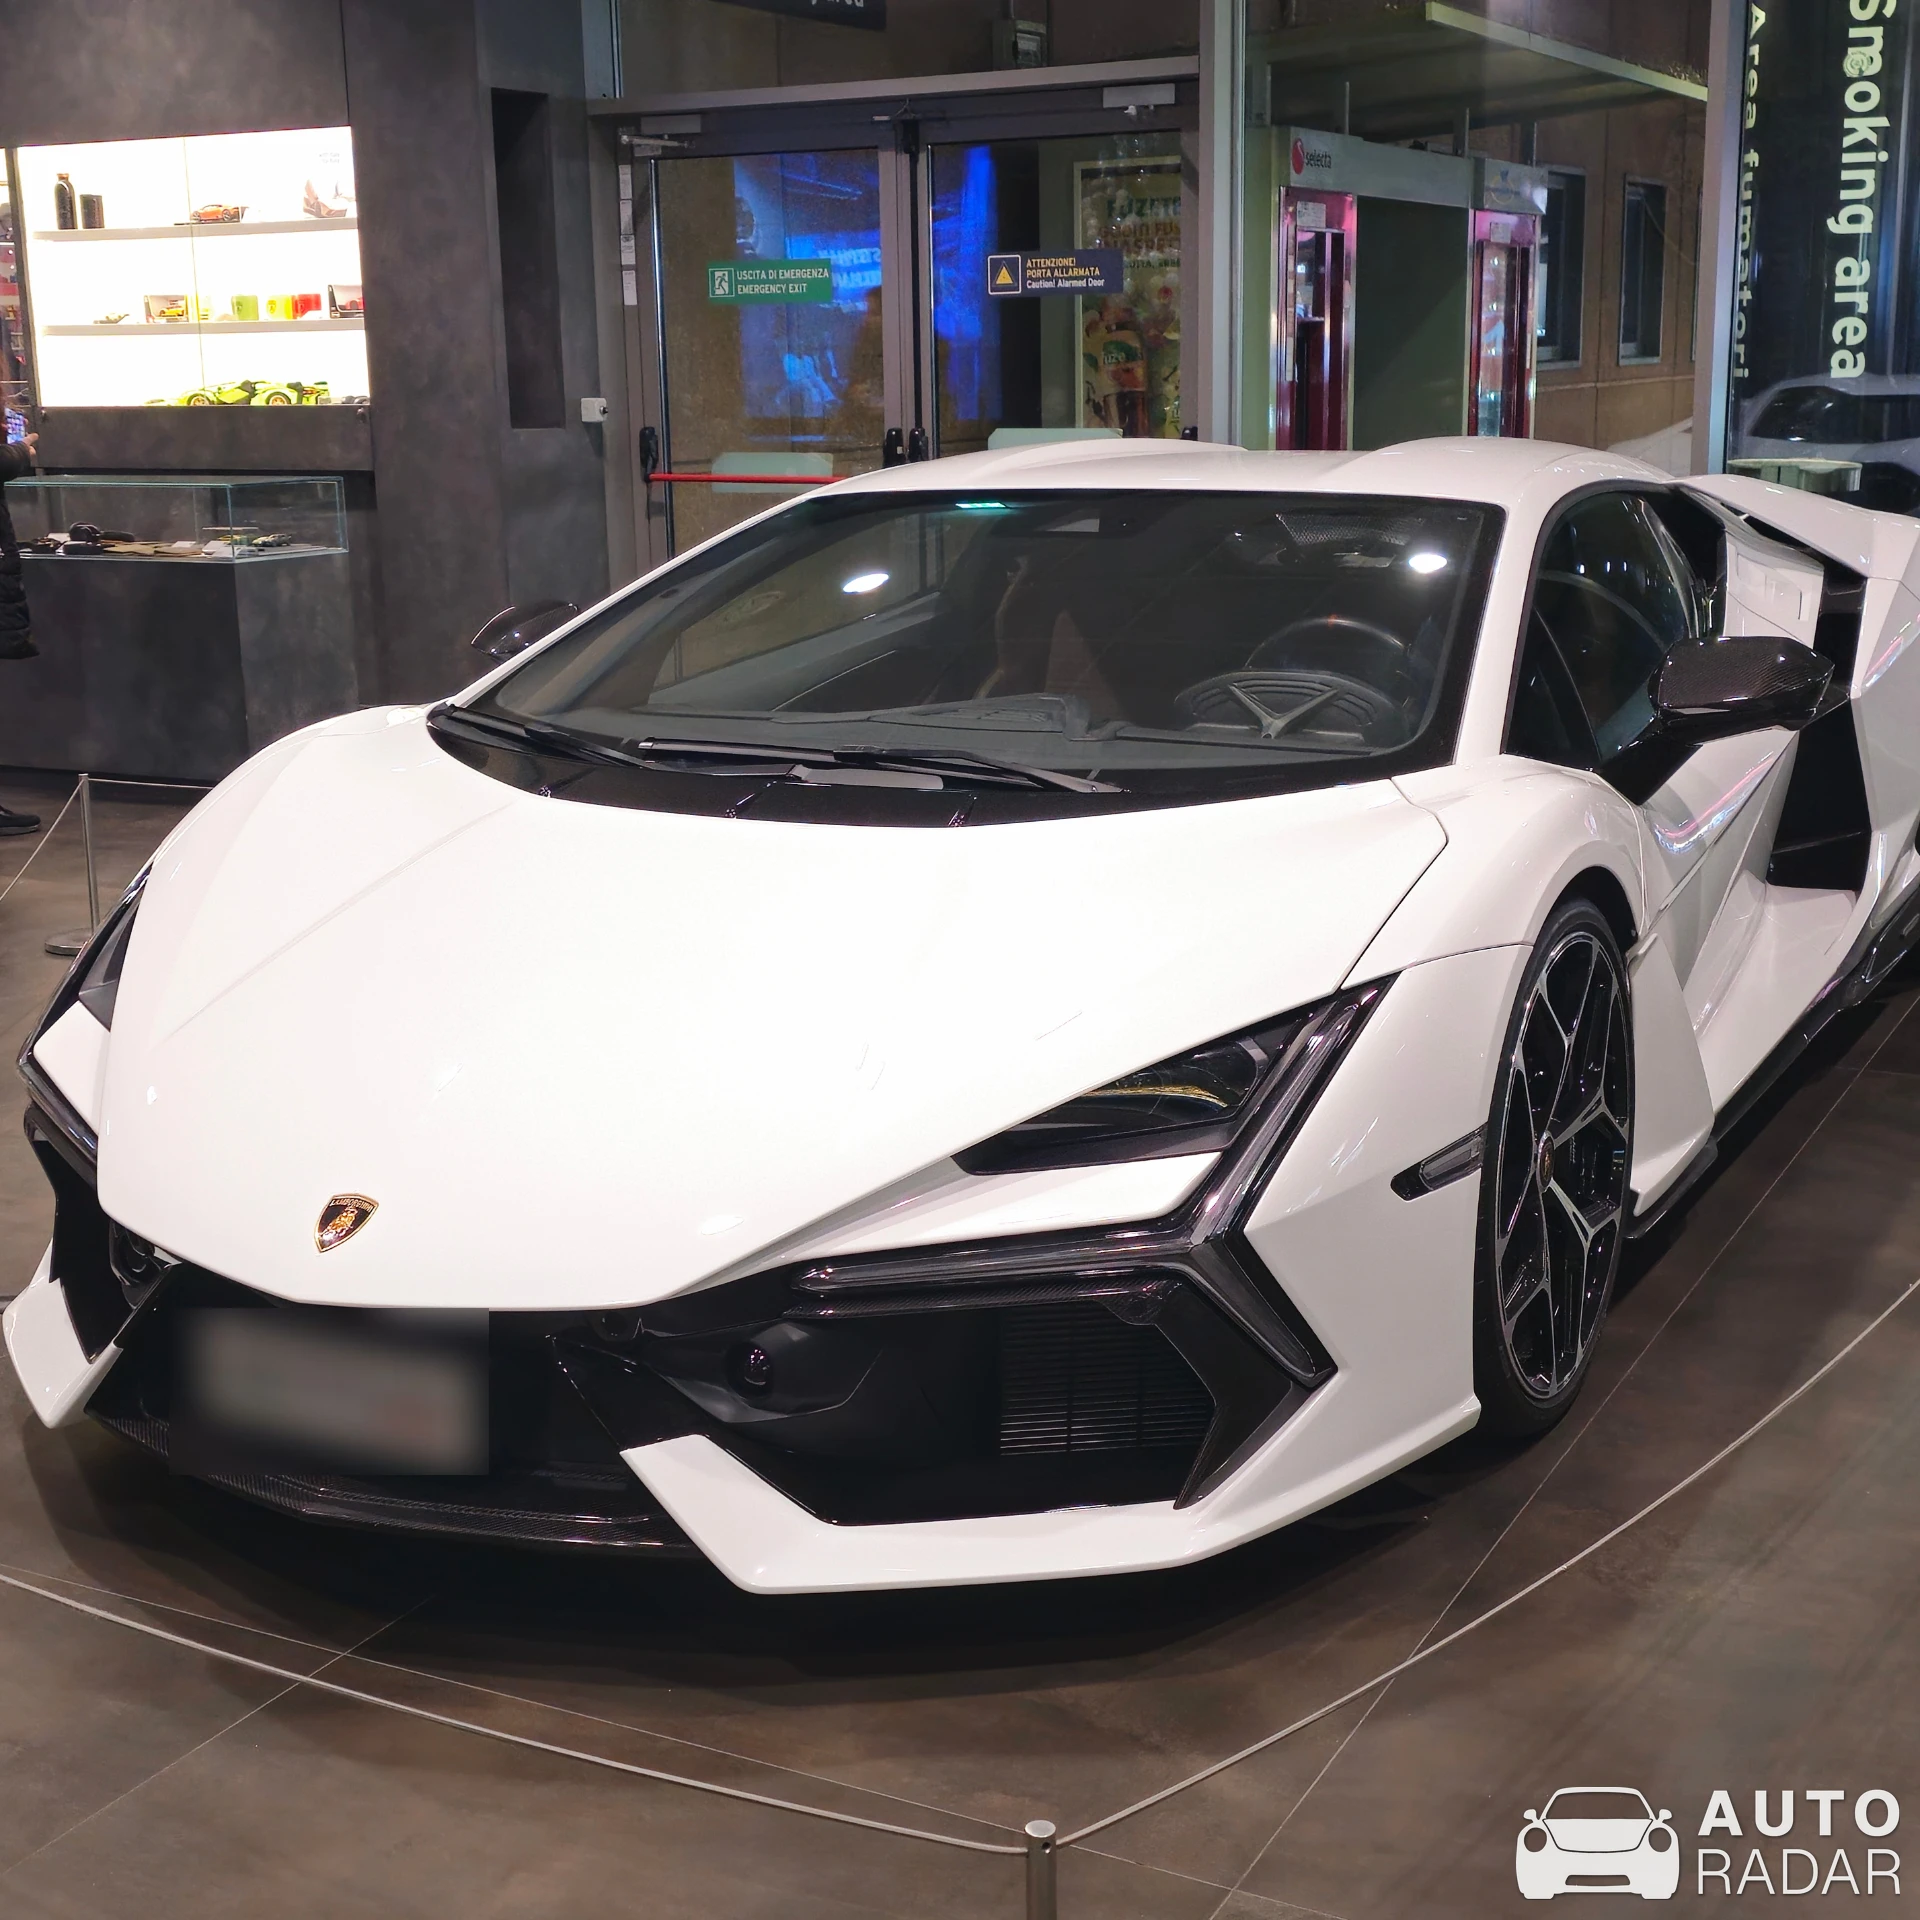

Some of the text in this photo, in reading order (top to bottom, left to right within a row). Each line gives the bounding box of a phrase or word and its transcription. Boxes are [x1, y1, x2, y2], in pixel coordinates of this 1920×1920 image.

[1305, 149, 1332, 169] selecta
[1734, 3, 1766, 378] Area fumatori
[1827, 0, 1897, 379] Smoking area
[1026, 257, 1076, 268] ATTENZIONE!
[737, 270, 767, 280] USCITA
[769, 270, 777, 279] DI
[779, 268, 829, 279] EMERGENZA
[1026, 267, 1100, 278] PORTA ALLARMATA
[737, 283, 807, 294] EMERGENCY EXIT
[1026, 278, 1105, 289] Caution! Alarmed Door
